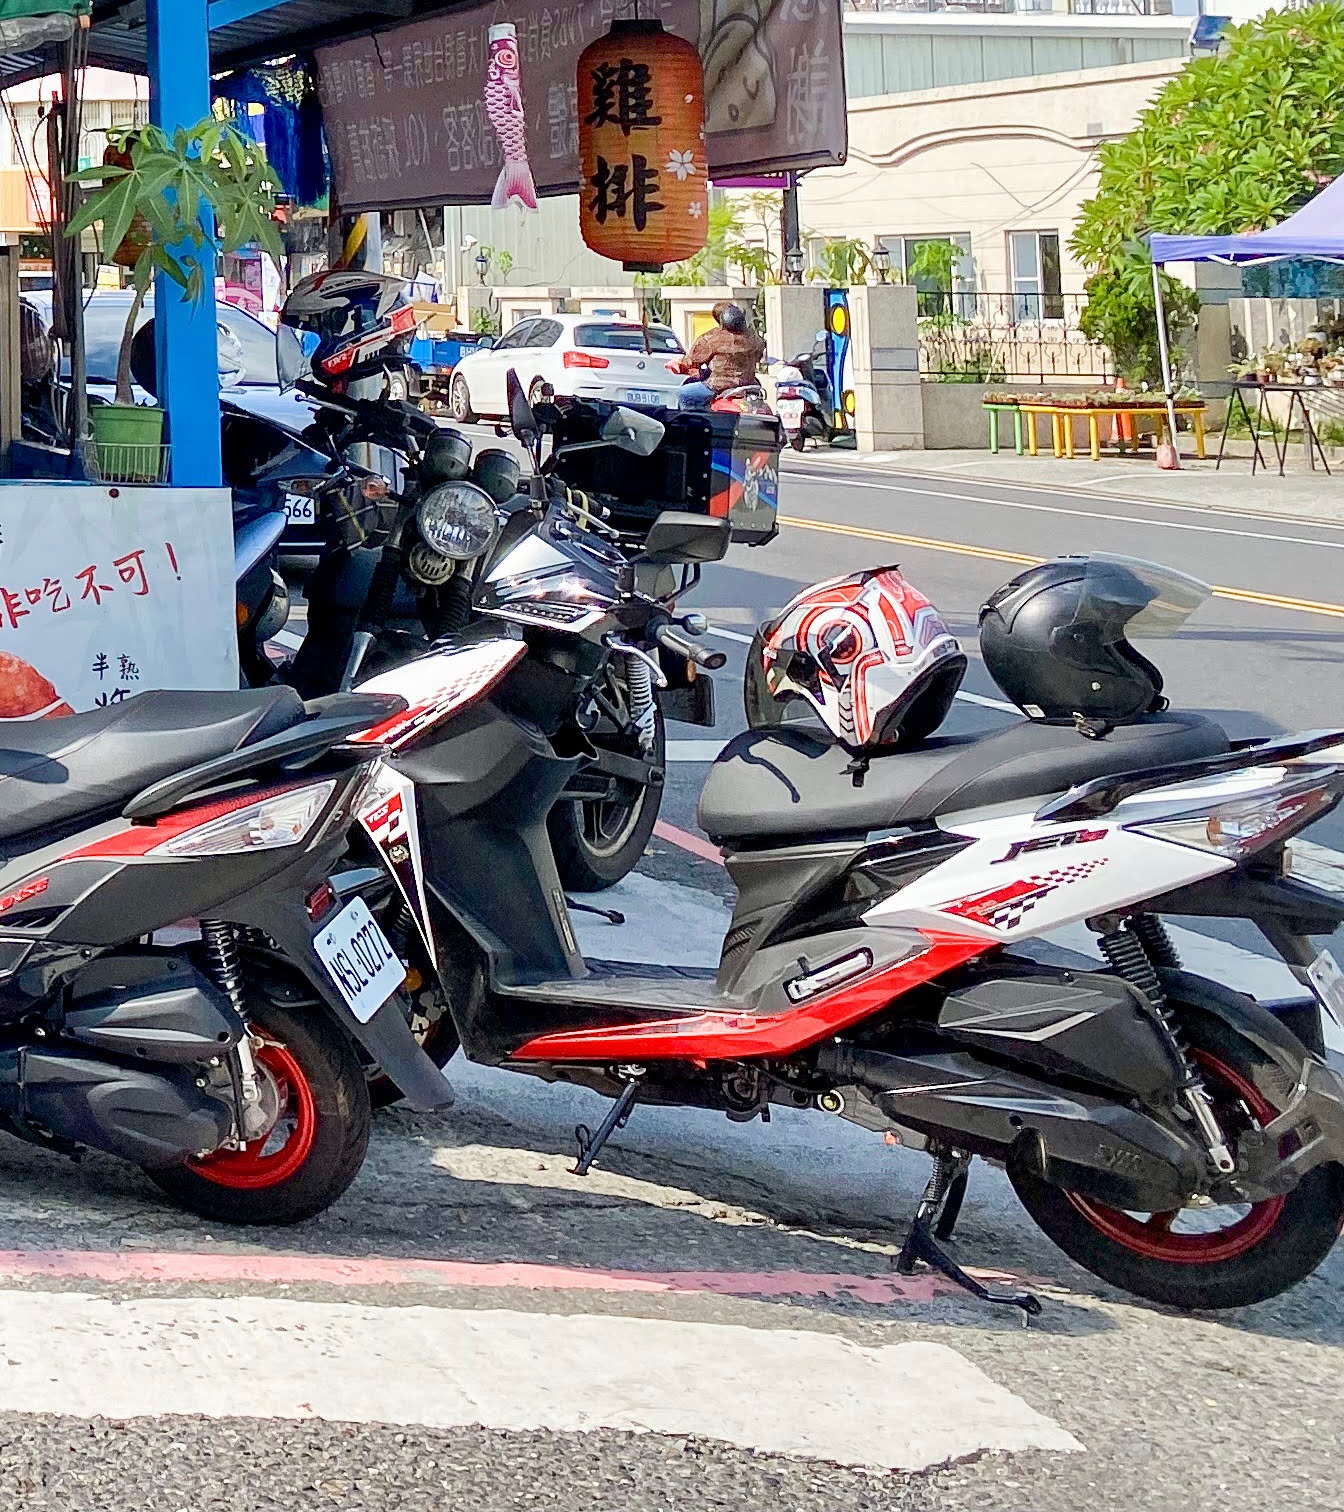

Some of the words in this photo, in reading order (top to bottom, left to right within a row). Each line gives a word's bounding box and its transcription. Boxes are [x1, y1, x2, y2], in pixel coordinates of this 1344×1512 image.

[586, 58, 664, 233] 雞排
[92, 653, 140, 682] 半熟
[329, 920, 393, 1001] NSL-0272
